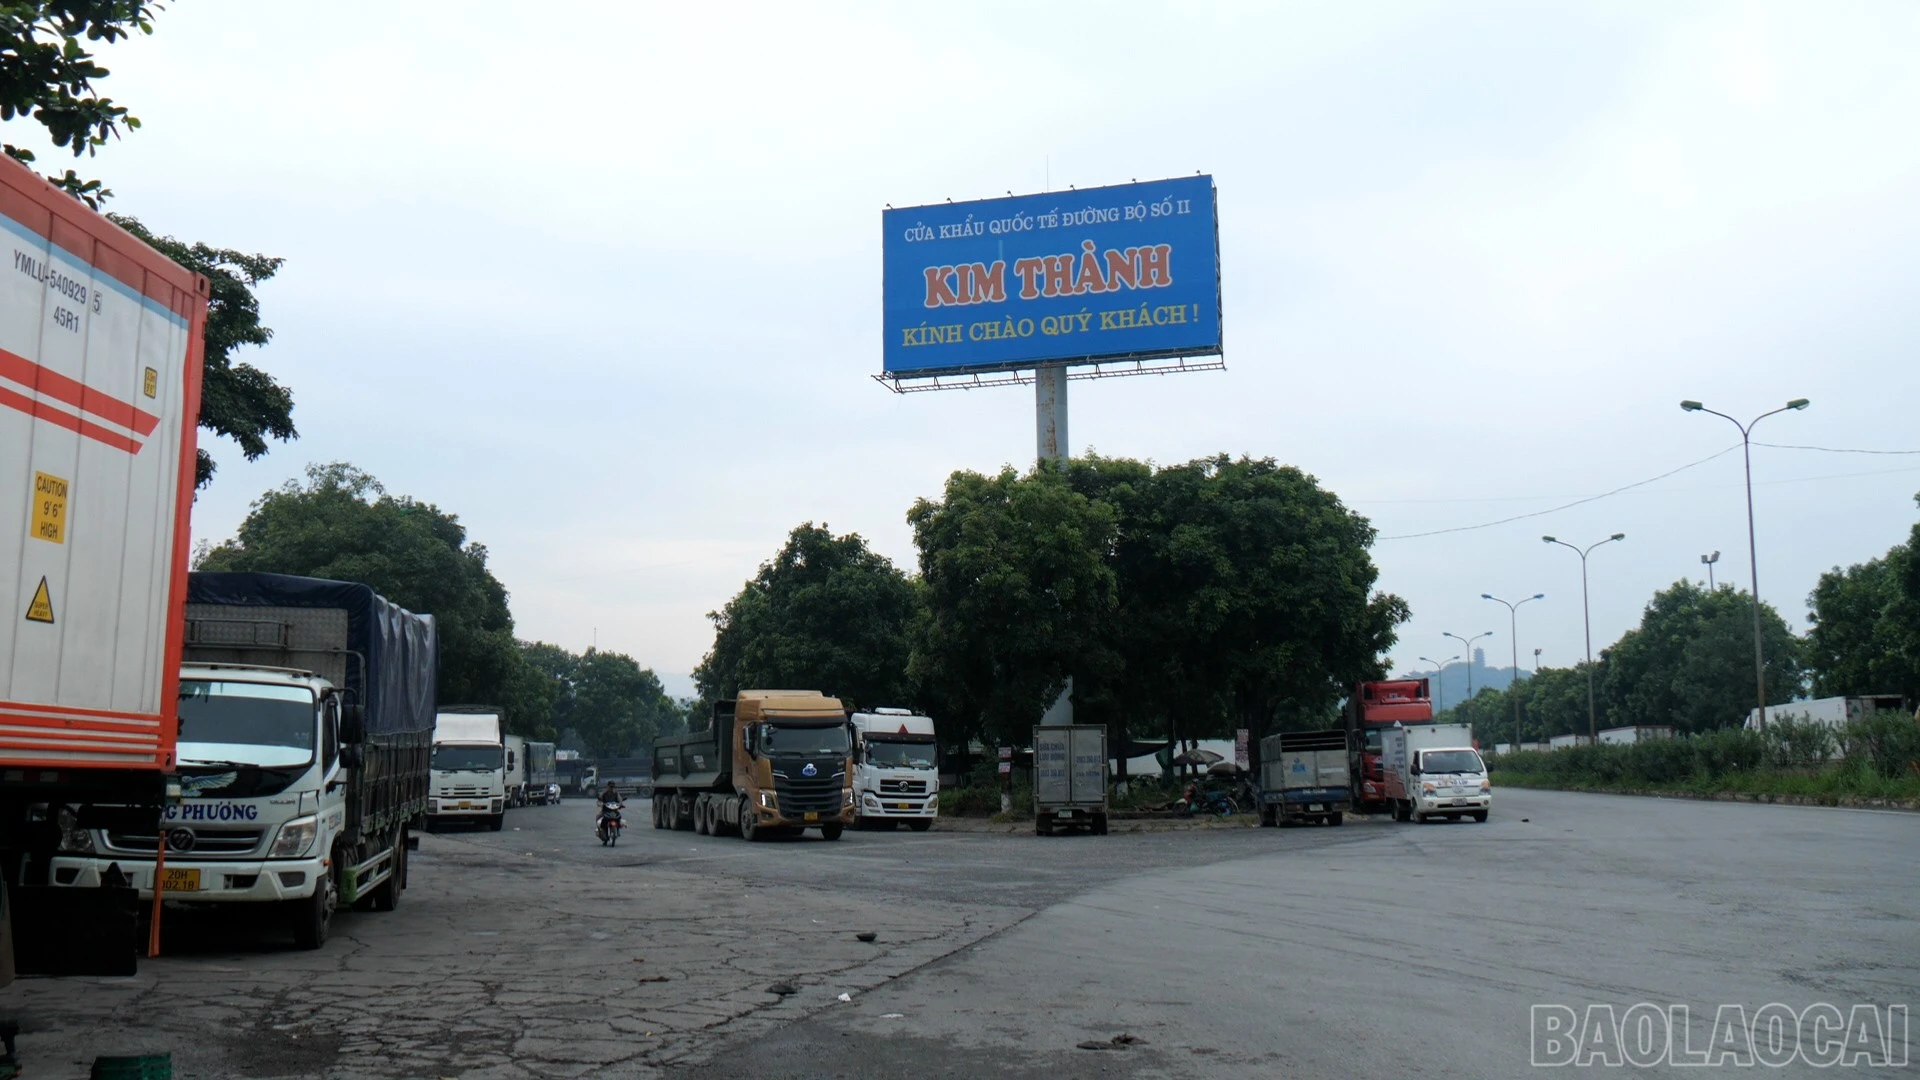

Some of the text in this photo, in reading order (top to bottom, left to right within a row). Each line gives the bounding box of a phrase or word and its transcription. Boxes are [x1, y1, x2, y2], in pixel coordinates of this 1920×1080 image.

[904, 194, 1191, 242] CỬA KHẨU QUỐC TẾ ĐƯỜNG BỘ SỐ II
[14, 249, 101, 312] YMLU-540929 5
[923, 239, 1172, 308] KIM THÀNH
[53, 305, 79, 334] 45R1
[902, 320, 963, 347] KÍNH
[969, 315, 1034, 341] CHÀO
[1040, 307, 1093, 336] QUÝ
[1100, 302, 1187, 331] KHÁCH
[36, 475, 68, 499] CAUTION
[40, 521, 58, 539] HIGH
